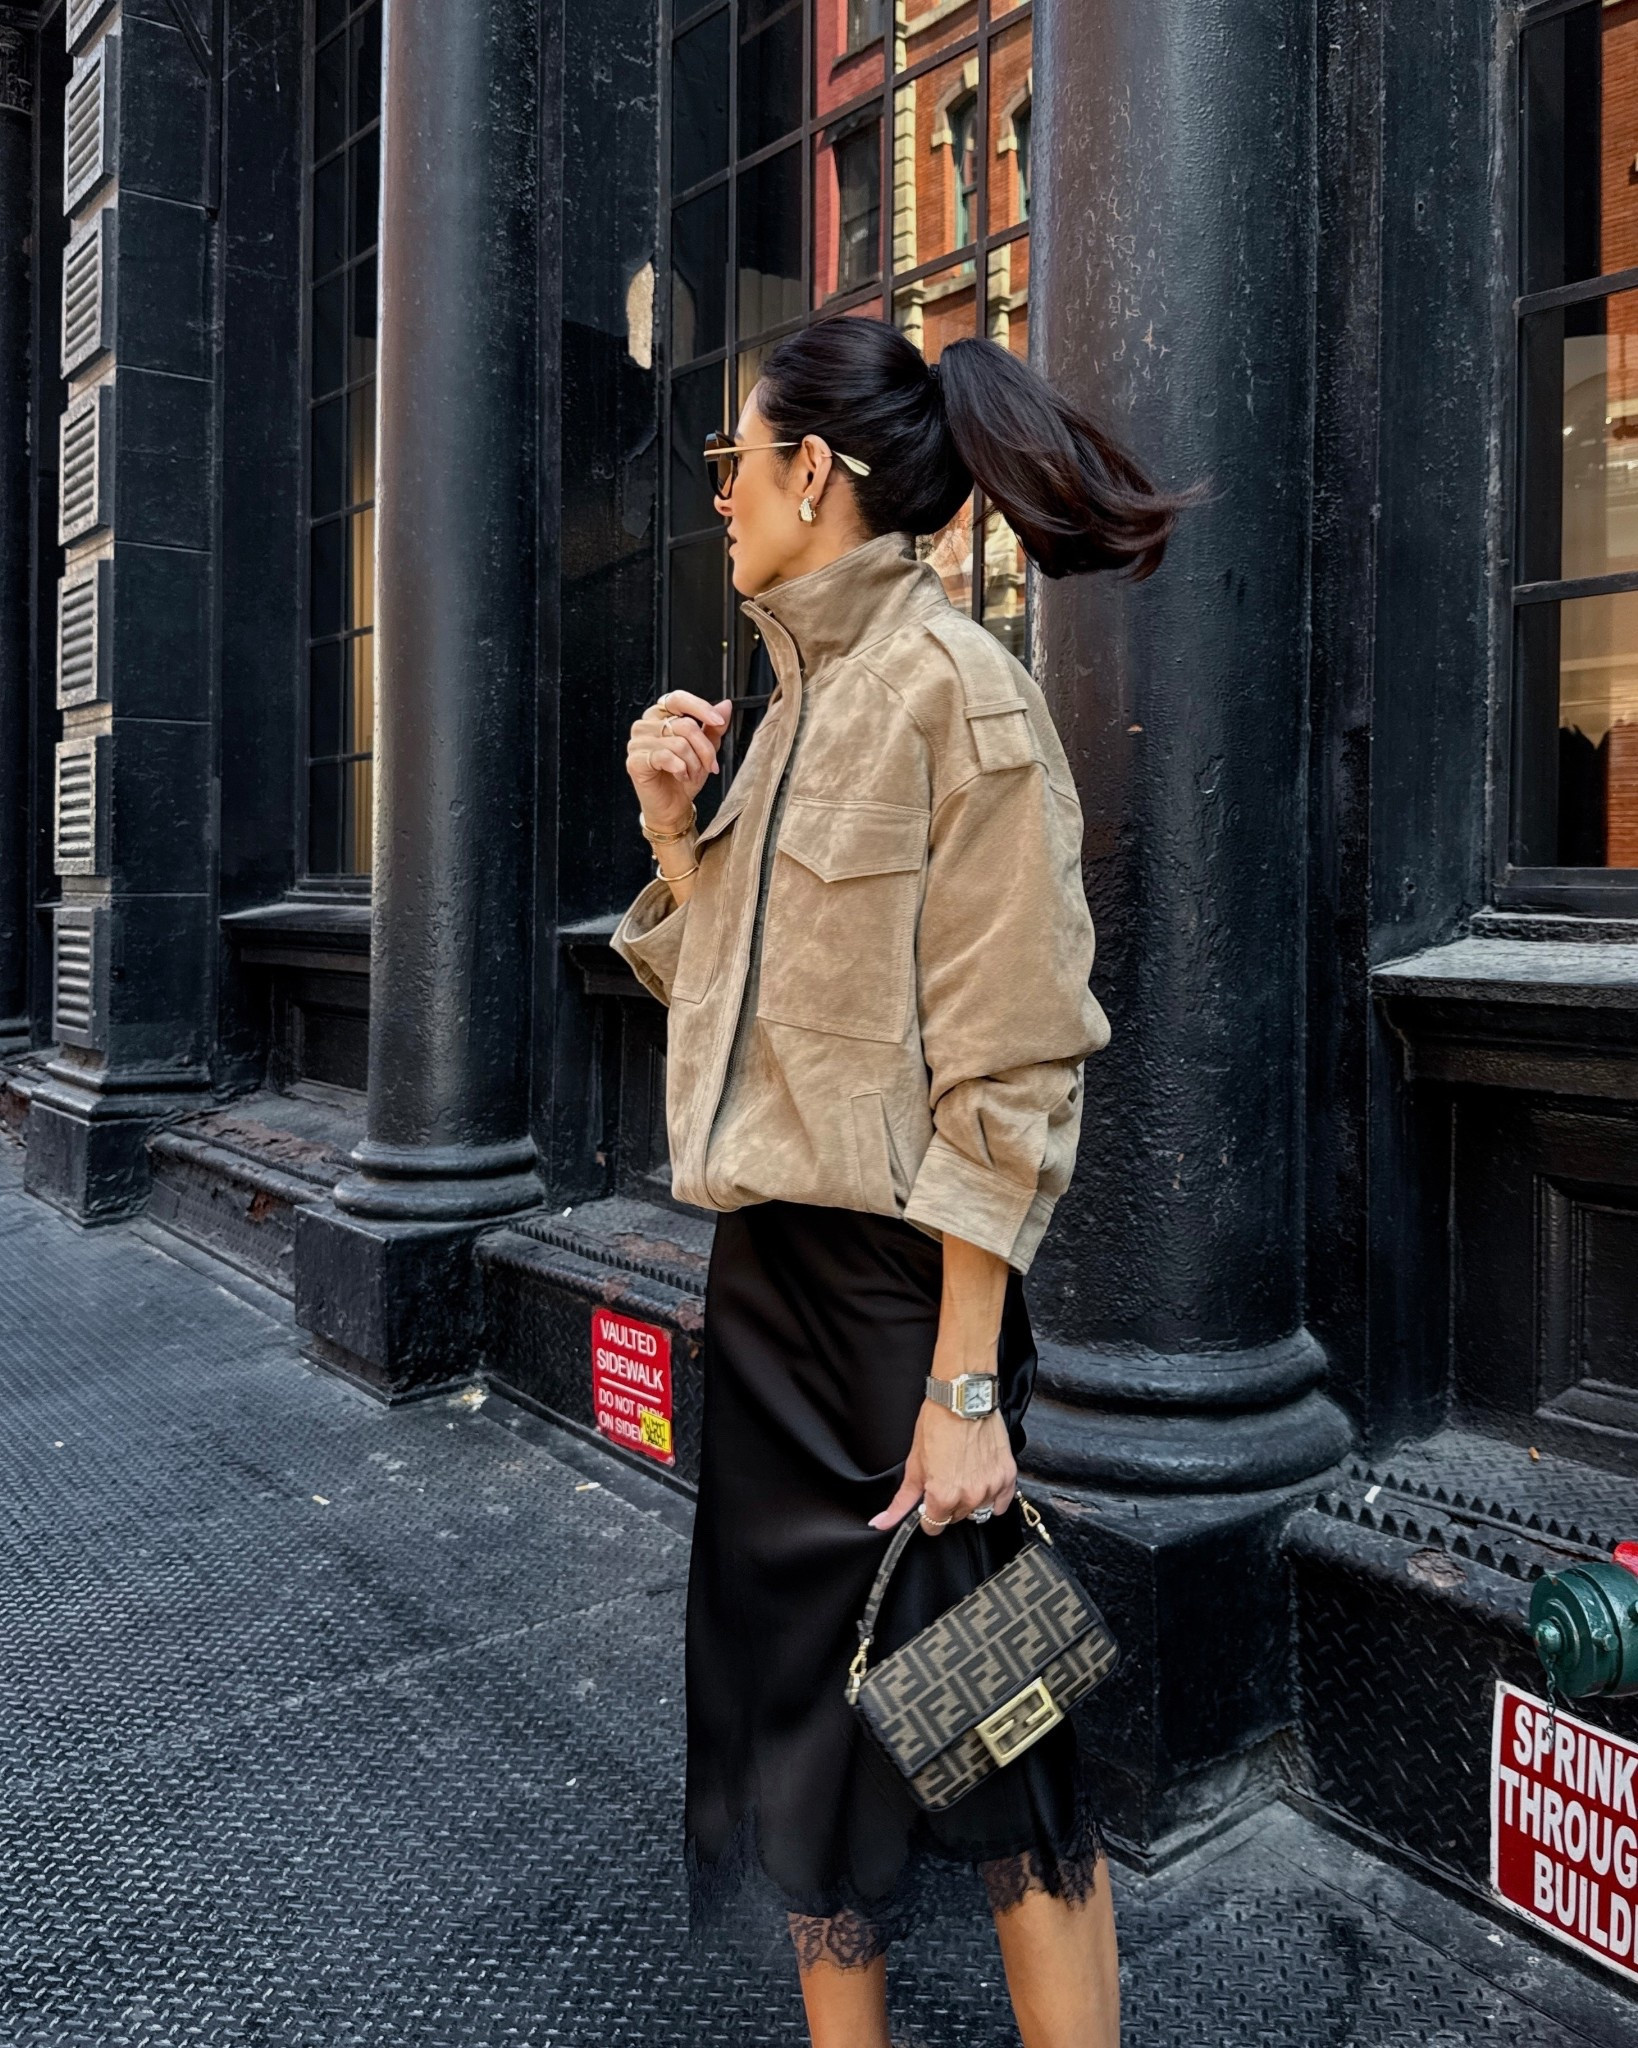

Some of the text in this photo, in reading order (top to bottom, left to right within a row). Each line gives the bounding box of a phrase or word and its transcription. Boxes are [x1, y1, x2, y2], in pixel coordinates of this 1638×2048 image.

[600, 1318, 657, 1357] VAULTED
[597, 1348, 664, 1391] SIDEWALK
[598, 1388, 614, 1409] DO
[615, 1394, 636, 1416] NOT
[598, 1411, 614, 1431] ON
[1513, 1704, 1638, 1820] SPRINK
[1499, 1764, 1638, 1889] THROUG
